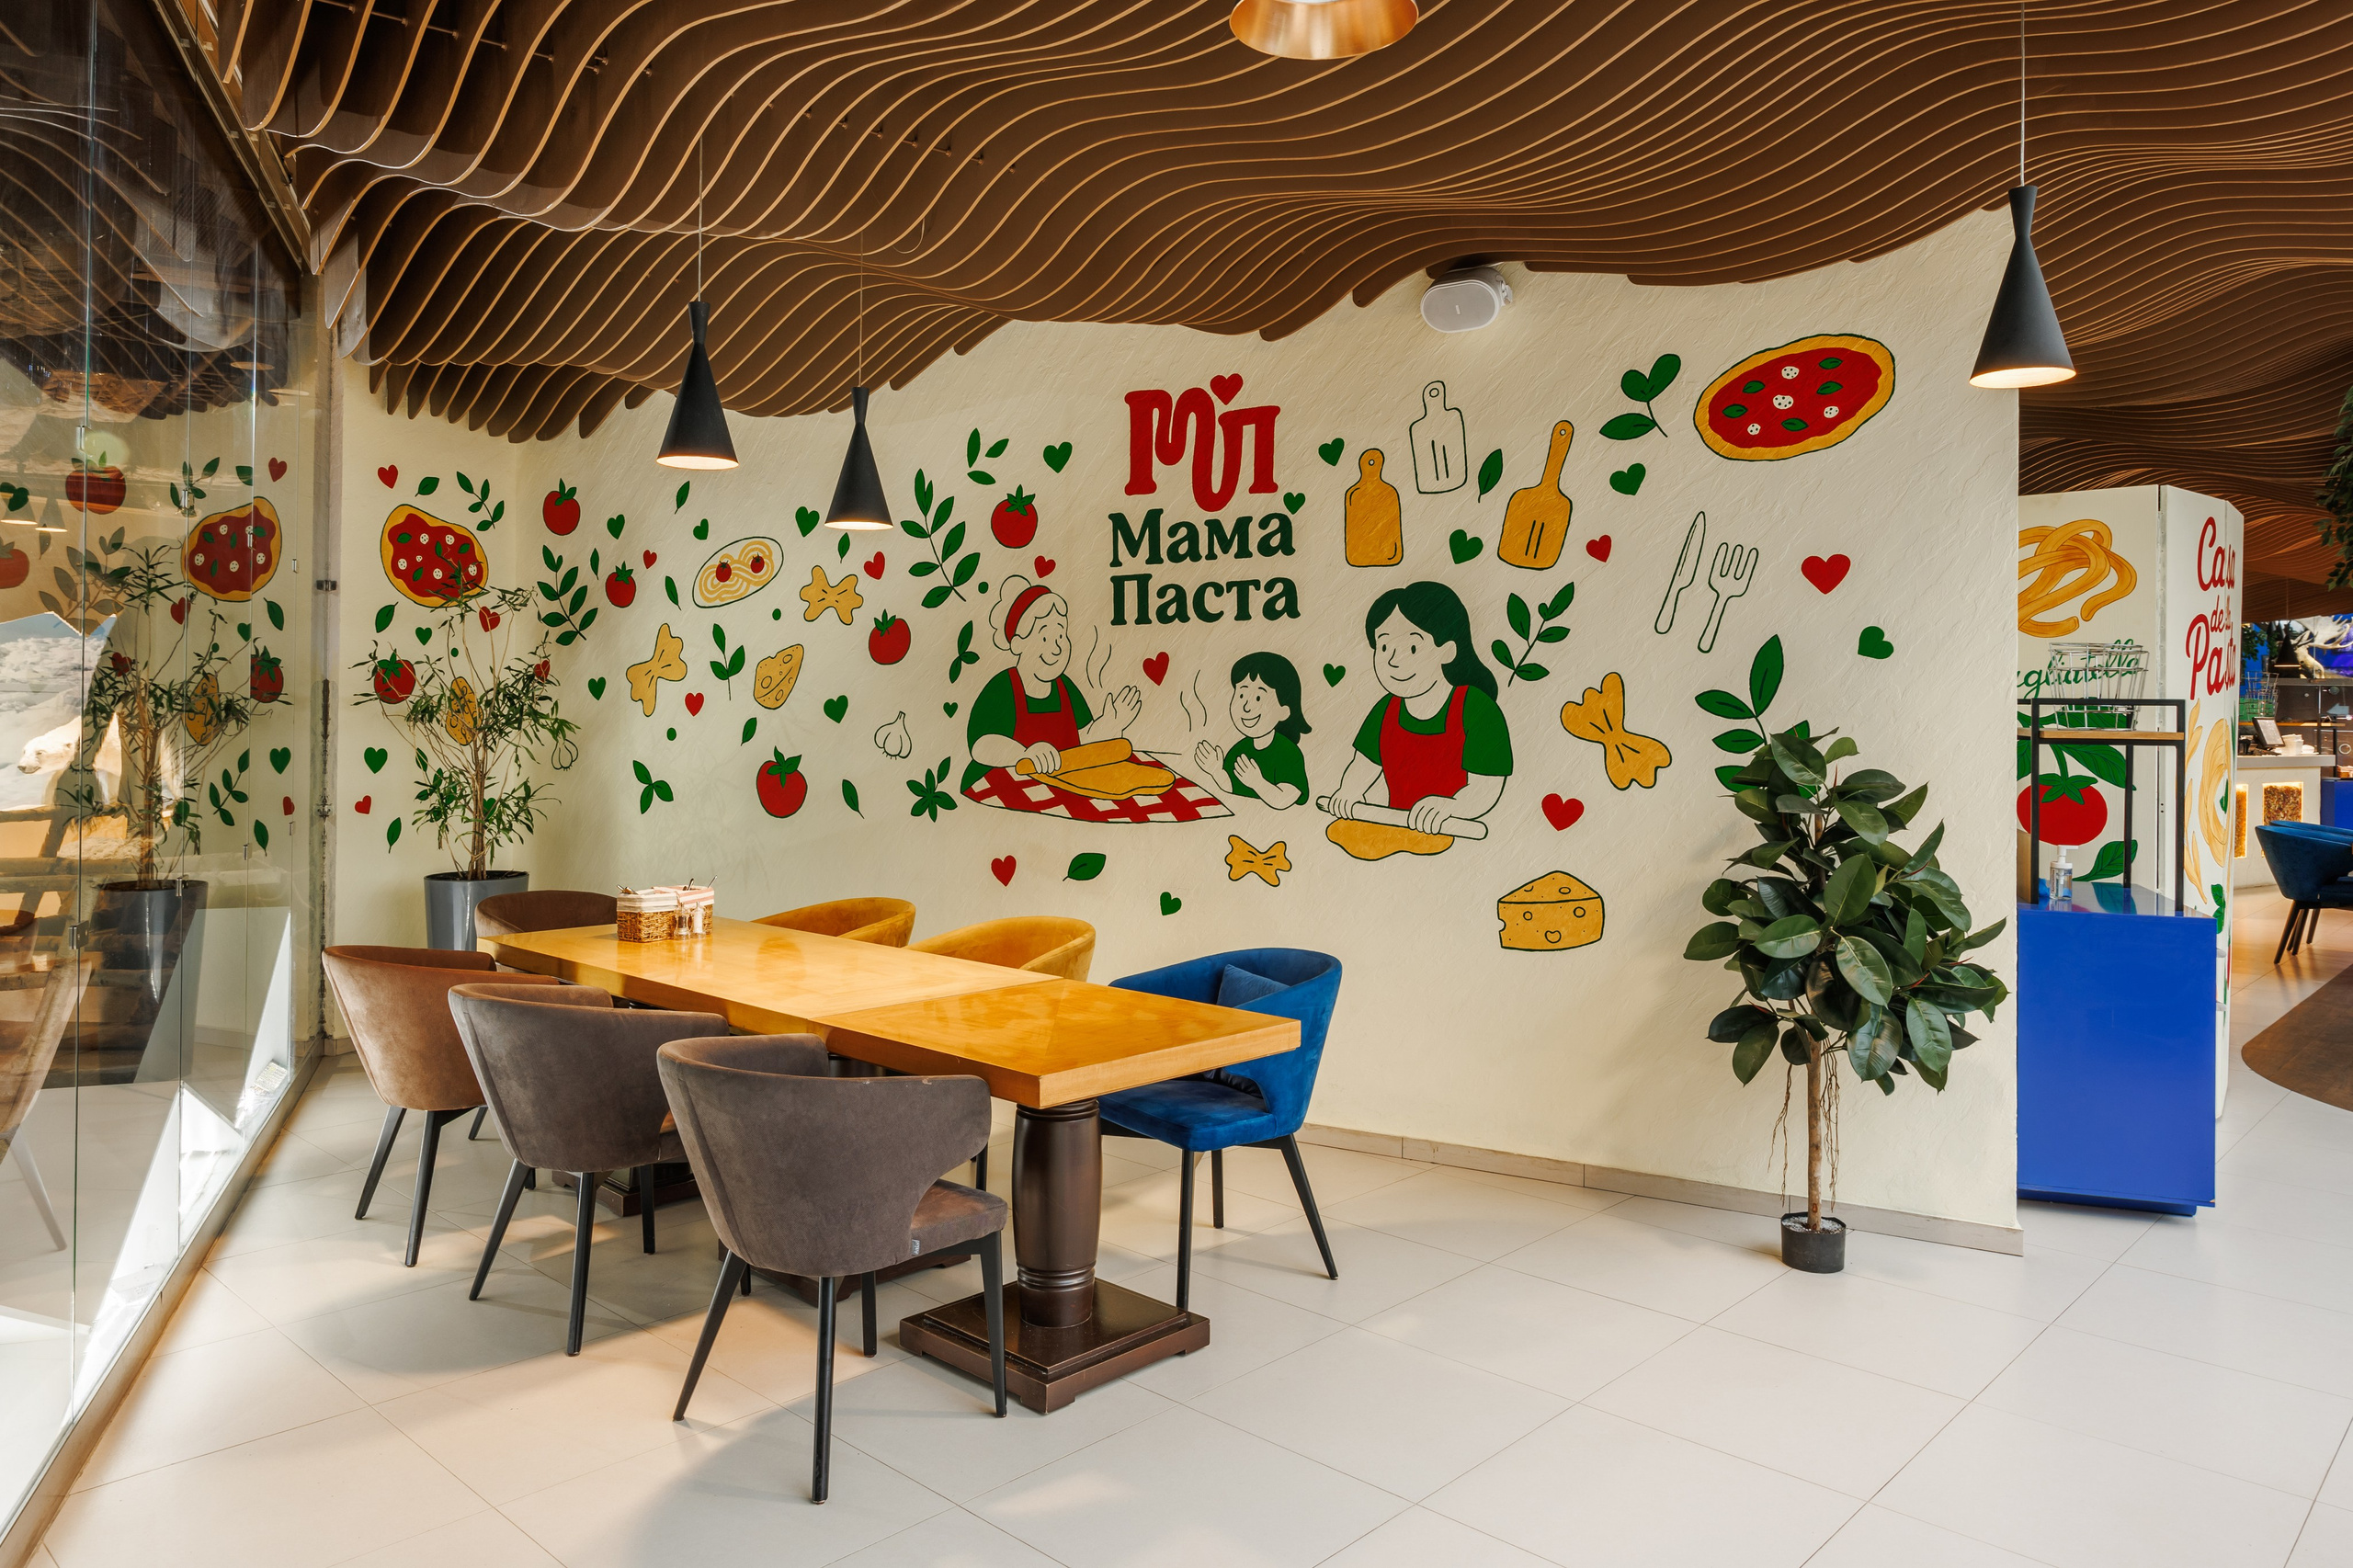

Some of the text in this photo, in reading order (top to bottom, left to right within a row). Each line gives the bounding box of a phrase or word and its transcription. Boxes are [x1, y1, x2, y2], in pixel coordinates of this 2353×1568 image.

[1108, 507, 1296, 567] Мама
[2197, 517, 2235, 591] Casa
[1109, 574, 1301, 626] Паста
[2186, 613, 2236, 700] Pasta
